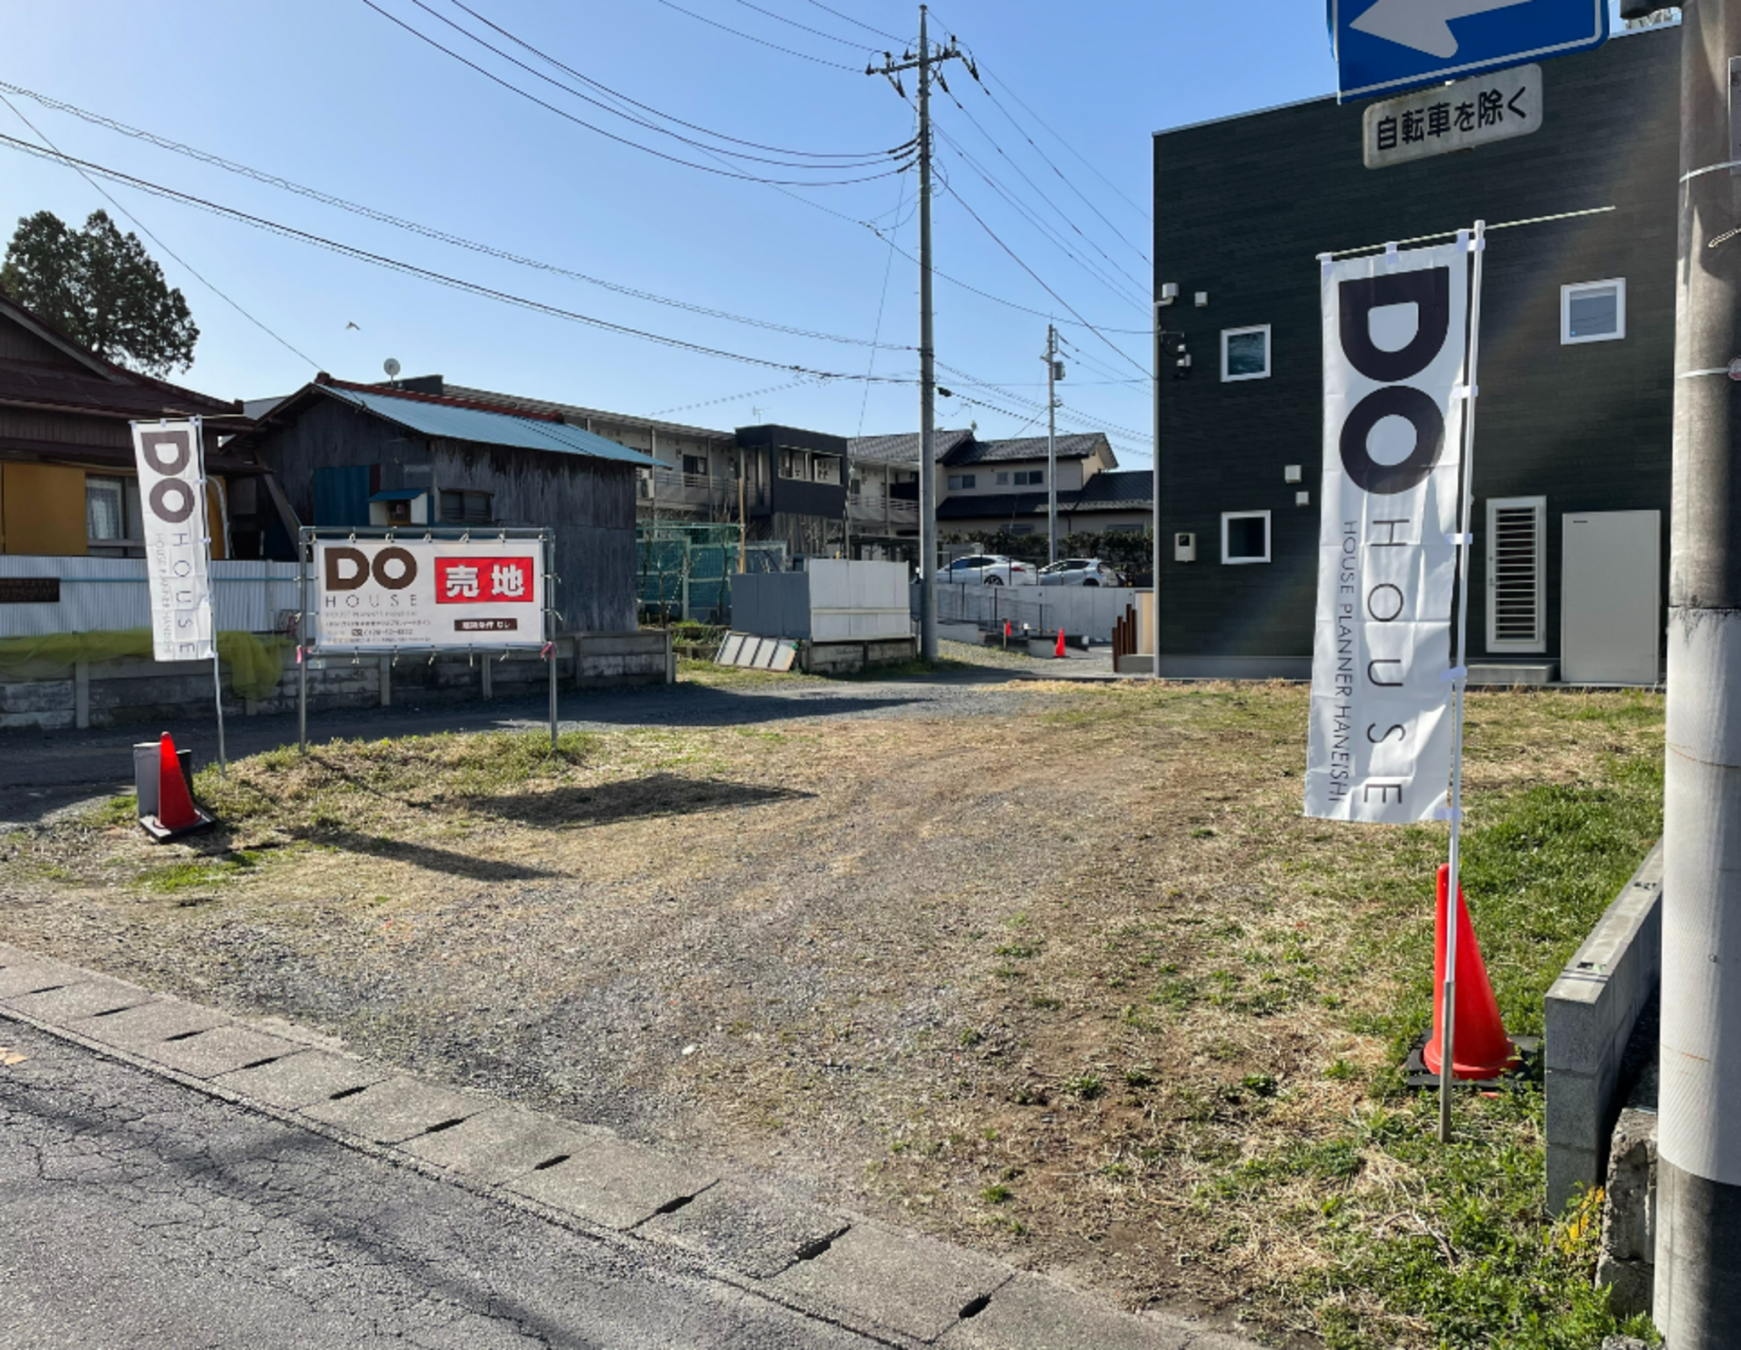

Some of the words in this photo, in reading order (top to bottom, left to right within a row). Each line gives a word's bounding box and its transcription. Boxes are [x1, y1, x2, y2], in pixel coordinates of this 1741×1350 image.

[1377, 86, 1527, 150] 自転車を除く
[1338, 265, 1450, 495] DO
[140, 430, 196, 523] DO
[172, 532, 195, 653] HOUSE
[324, 546, 418, 591] DO
[325, 594, 417, 608] HOUSE
[445, 564, 526, 598] 売地
[1339, 519, 1358, 594] HOUSE
[1334, 603, 1354, 697] PLANNER
[1363, 518, 1410, 804] HOUSE
[1328, 704, 1354, 802] HANEISHI
